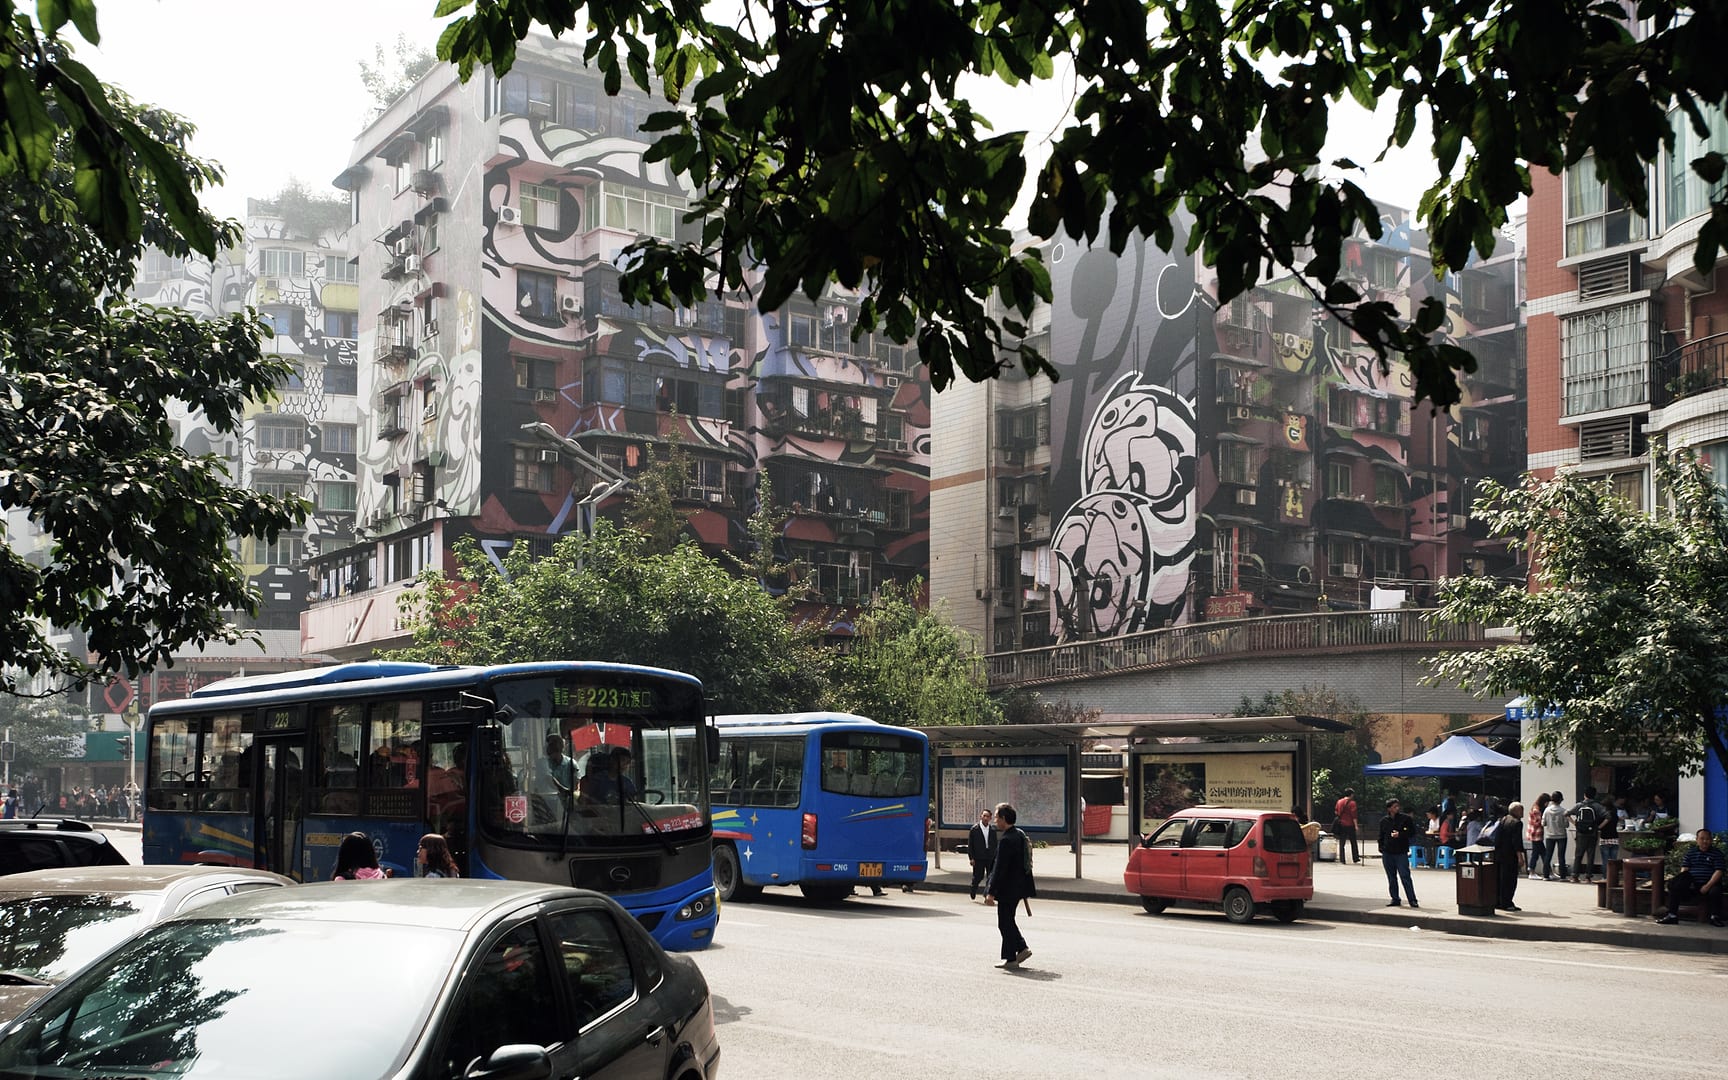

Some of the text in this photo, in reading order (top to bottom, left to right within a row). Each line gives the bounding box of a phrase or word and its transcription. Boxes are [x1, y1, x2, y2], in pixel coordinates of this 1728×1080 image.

[587, 688, 619, 708] 223
[274, 712, 289, 728] 223
[863, 736, 881, 746] 223
[1210, 787, 1282, 798] 公园里的洋房时光
[833, 863, 849, 872] CNG
[860, 868, 881, 877] 41119
